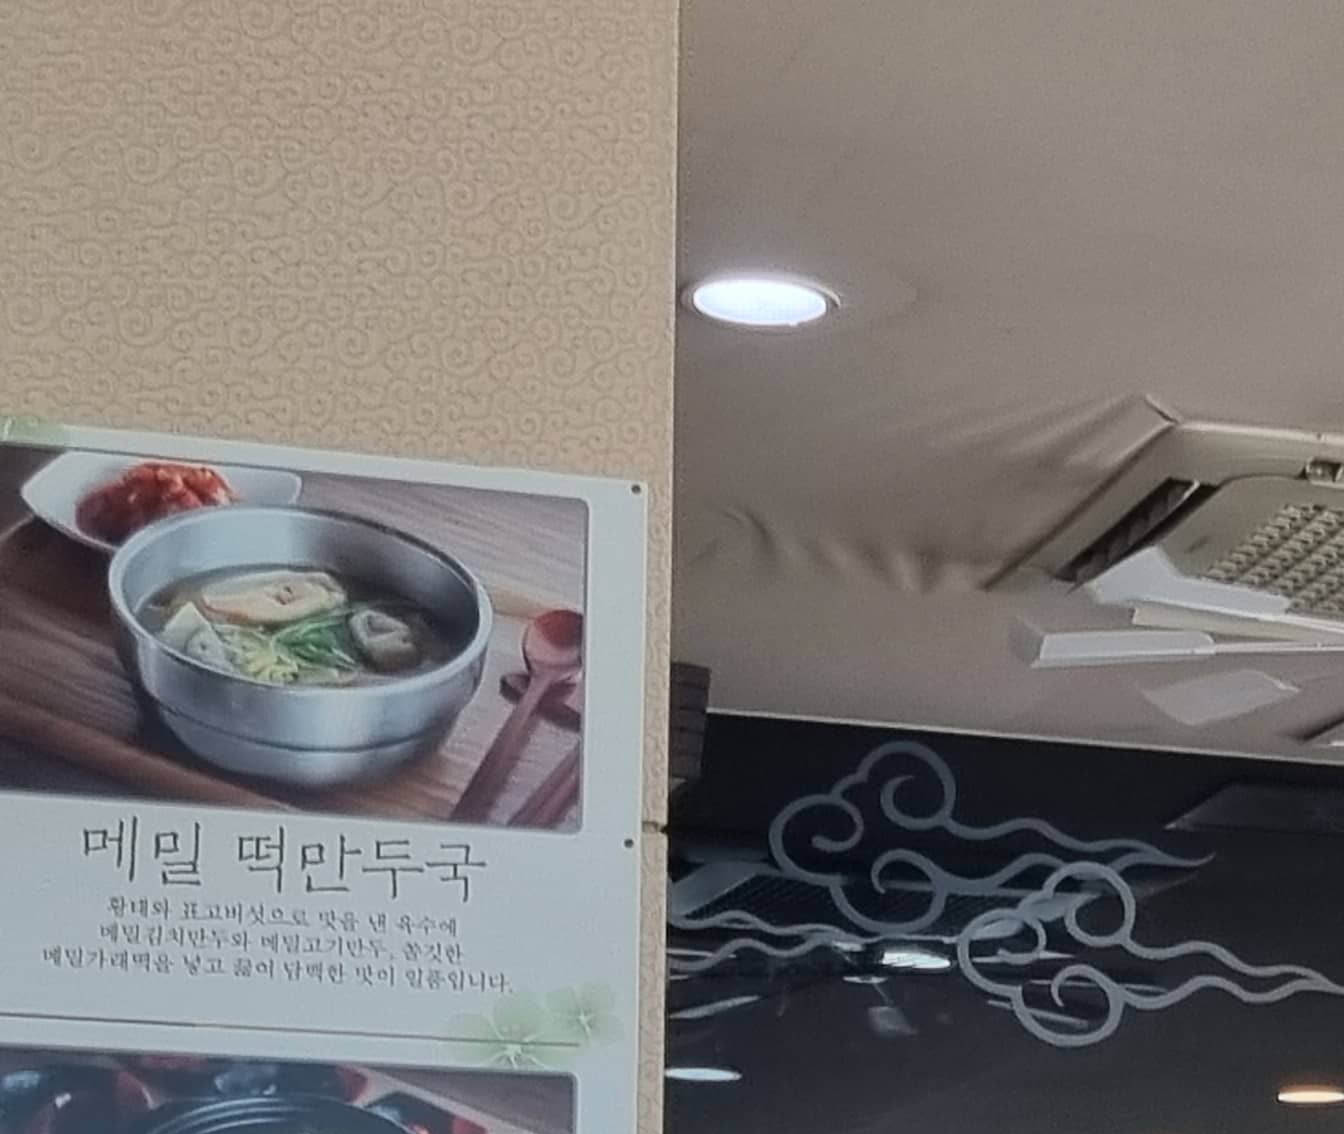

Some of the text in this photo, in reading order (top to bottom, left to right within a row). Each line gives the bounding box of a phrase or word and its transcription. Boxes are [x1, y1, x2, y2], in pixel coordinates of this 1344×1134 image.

[83, 816, 487, 903] 메밀 떡만두국
[180, 901, 309, 927] 표고버섯으로
[319, 909, 358, 932] 맛을
[183, 953, 227, 976] 넣고
[284, 959, 347, 984] 담백한
[356, 965, 395, 987] 맛이
